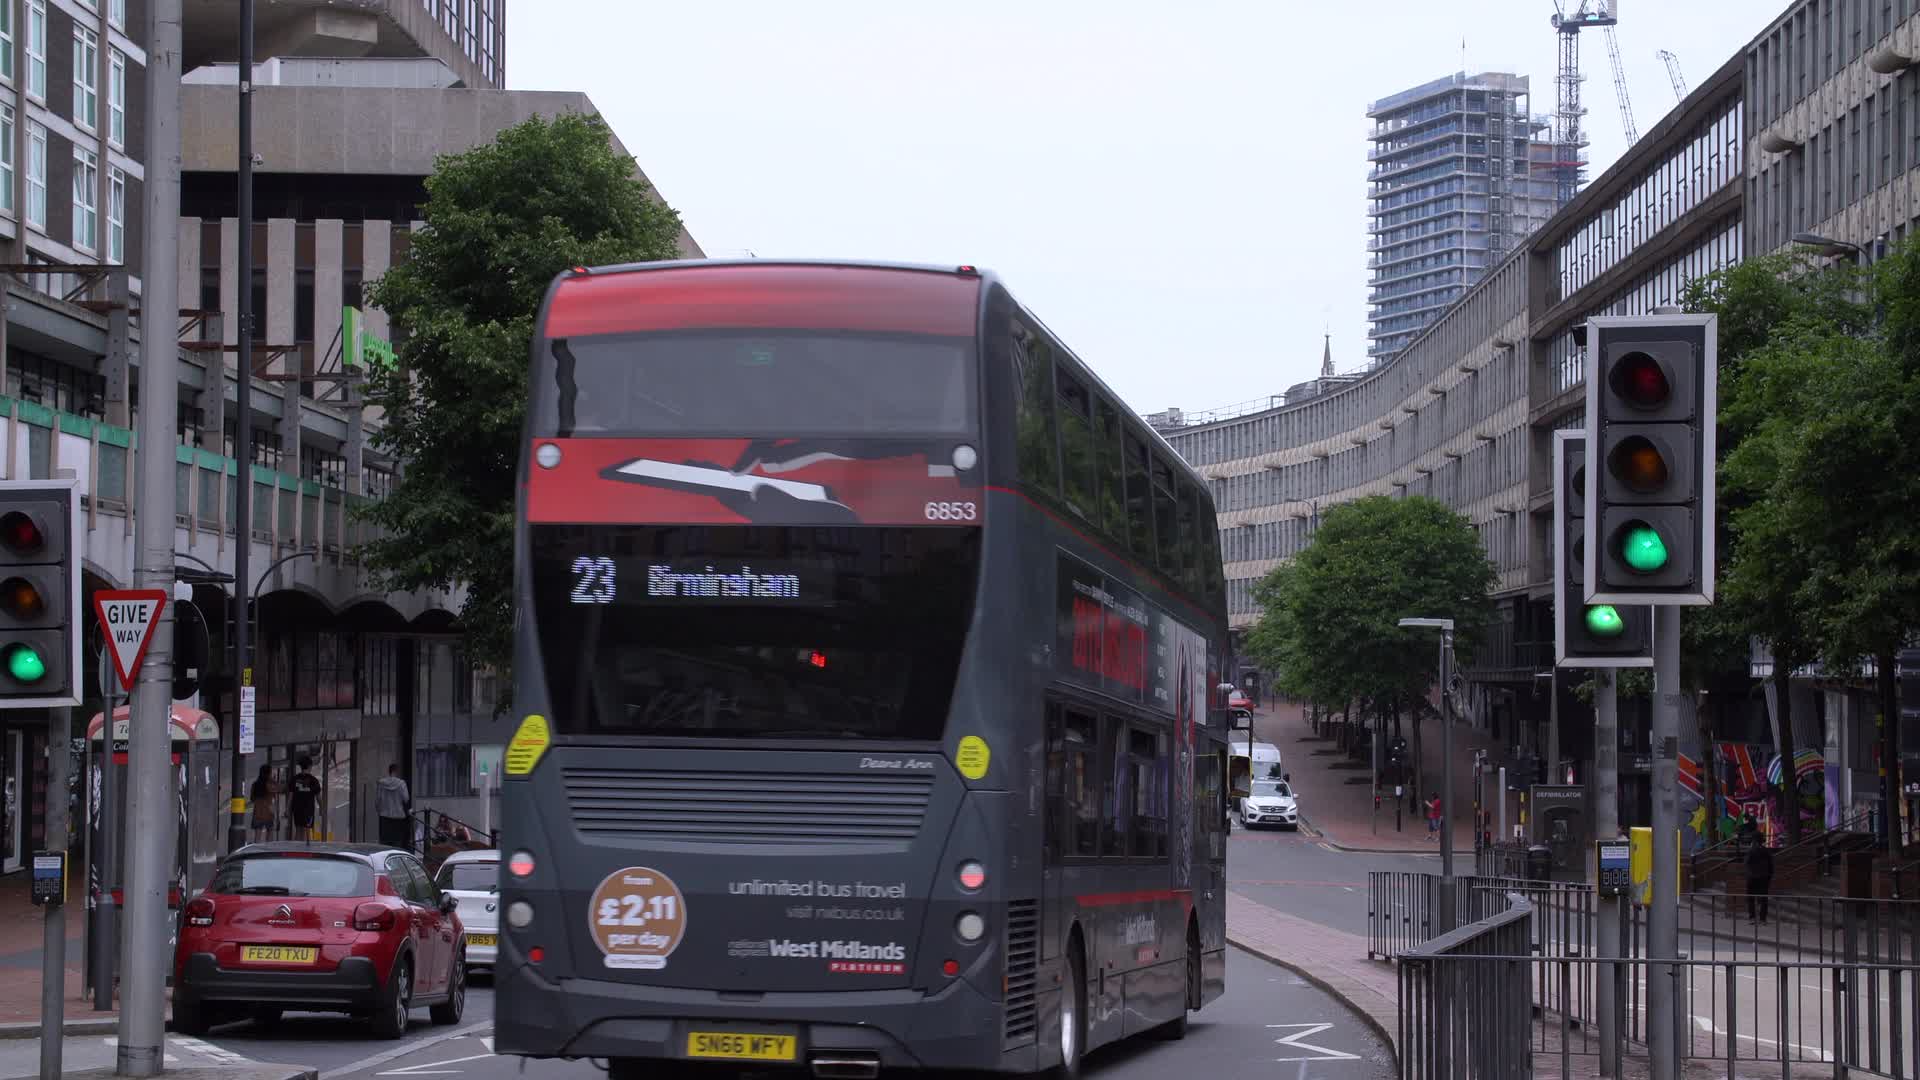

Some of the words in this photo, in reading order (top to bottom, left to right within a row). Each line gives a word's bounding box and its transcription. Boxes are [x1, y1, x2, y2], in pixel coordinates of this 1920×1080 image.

[924, 501, 977, 520] 6853
[570, 557, 616, 604] 23
[107, 604, 148, 624] GIVE
[116, 630, 142, 643] WAY
[903, 758, 934, 769] Ann
[728, 879, 814, 896] unlimited
[816, 880, 852, 897] bus
[855, 881, 906, 898] travel
[598, 895, 676, 926] £2.11
[607, 934, 636, 948] per
[637, 932, 671, 949] day
[769, 939, 818, 958] West
[821, 940, 906, 960] Midlands
[248, 947, 281, 961] FE20
[285, 948, 310, 962] TXU
[831, 962, 905, 973] PLATINUM
[697, 1034, 744, 1054] SN66
[750, 1036, 786, 1056] WFY
